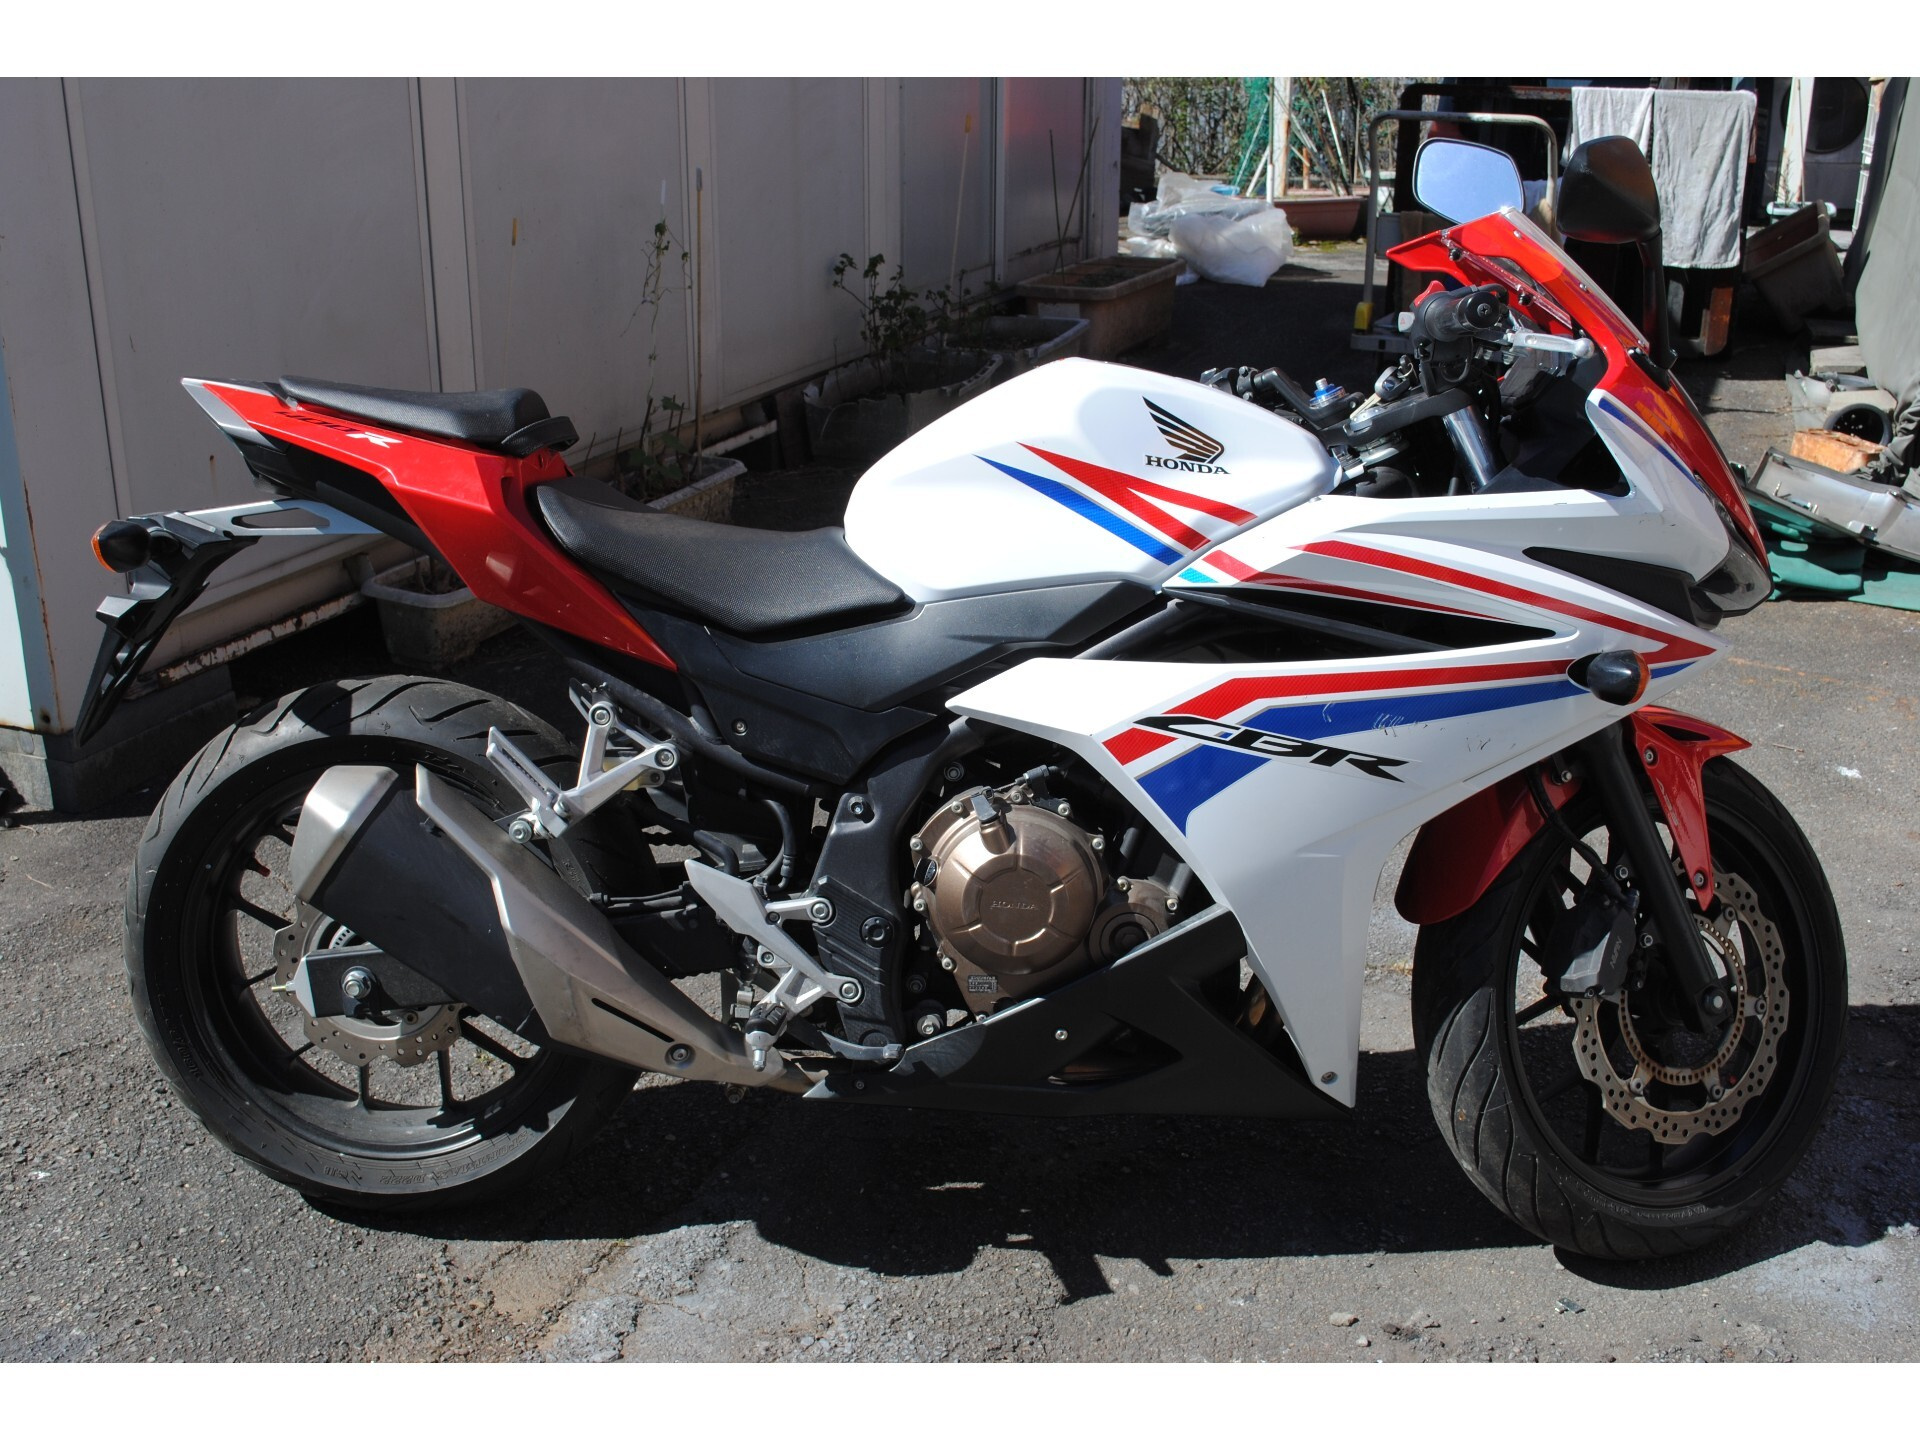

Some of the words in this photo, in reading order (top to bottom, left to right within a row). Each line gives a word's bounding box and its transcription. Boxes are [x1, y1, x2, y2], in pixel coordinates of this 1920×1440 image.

[1144, 454, 1231, 475] HONDA
[1132, 716, 1410, 783] CBR
[990, 900, 1038, 911] HONDA
